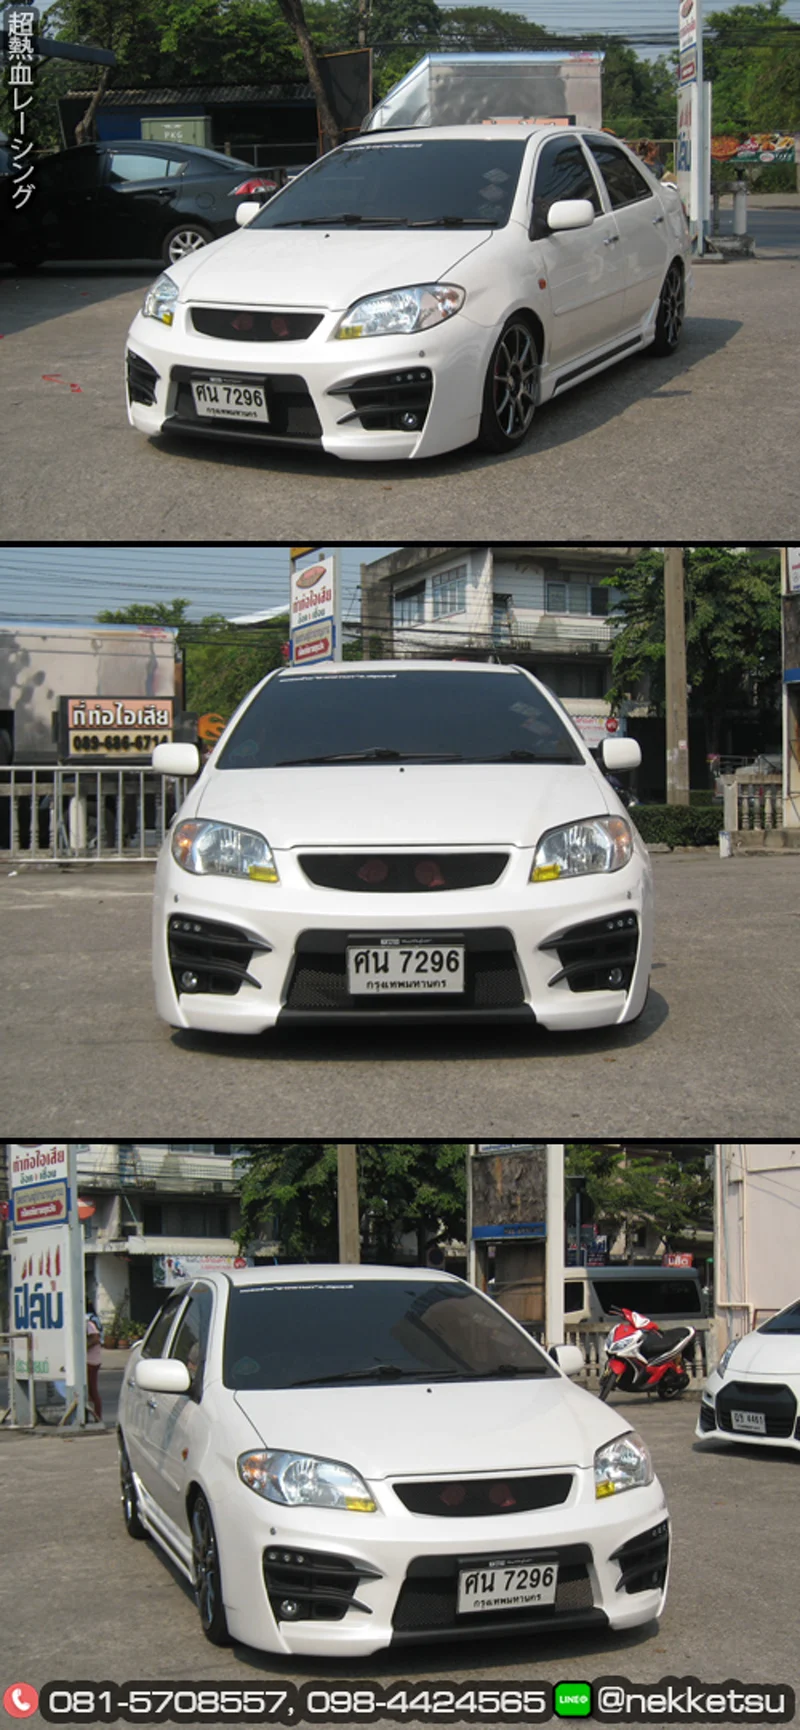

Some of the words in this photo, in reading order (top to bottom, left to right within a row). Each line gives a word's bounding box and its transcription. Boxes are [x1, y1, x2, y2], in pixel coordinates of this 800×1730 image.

[196, 384, 219, 402] ศน
[223, 386, 263, 407] 7296
[354, 949, 389, 974] ศน
[399, 950, 460, 973] 7296
[366, 980, 447, 992] กรุงเทพมหานคร
[465, 1572, 495, 1594] ศน
[504, 1567, 554, 1591] 7296
[473, 1594, 542, 1608] กรุงเทพมหานคร
